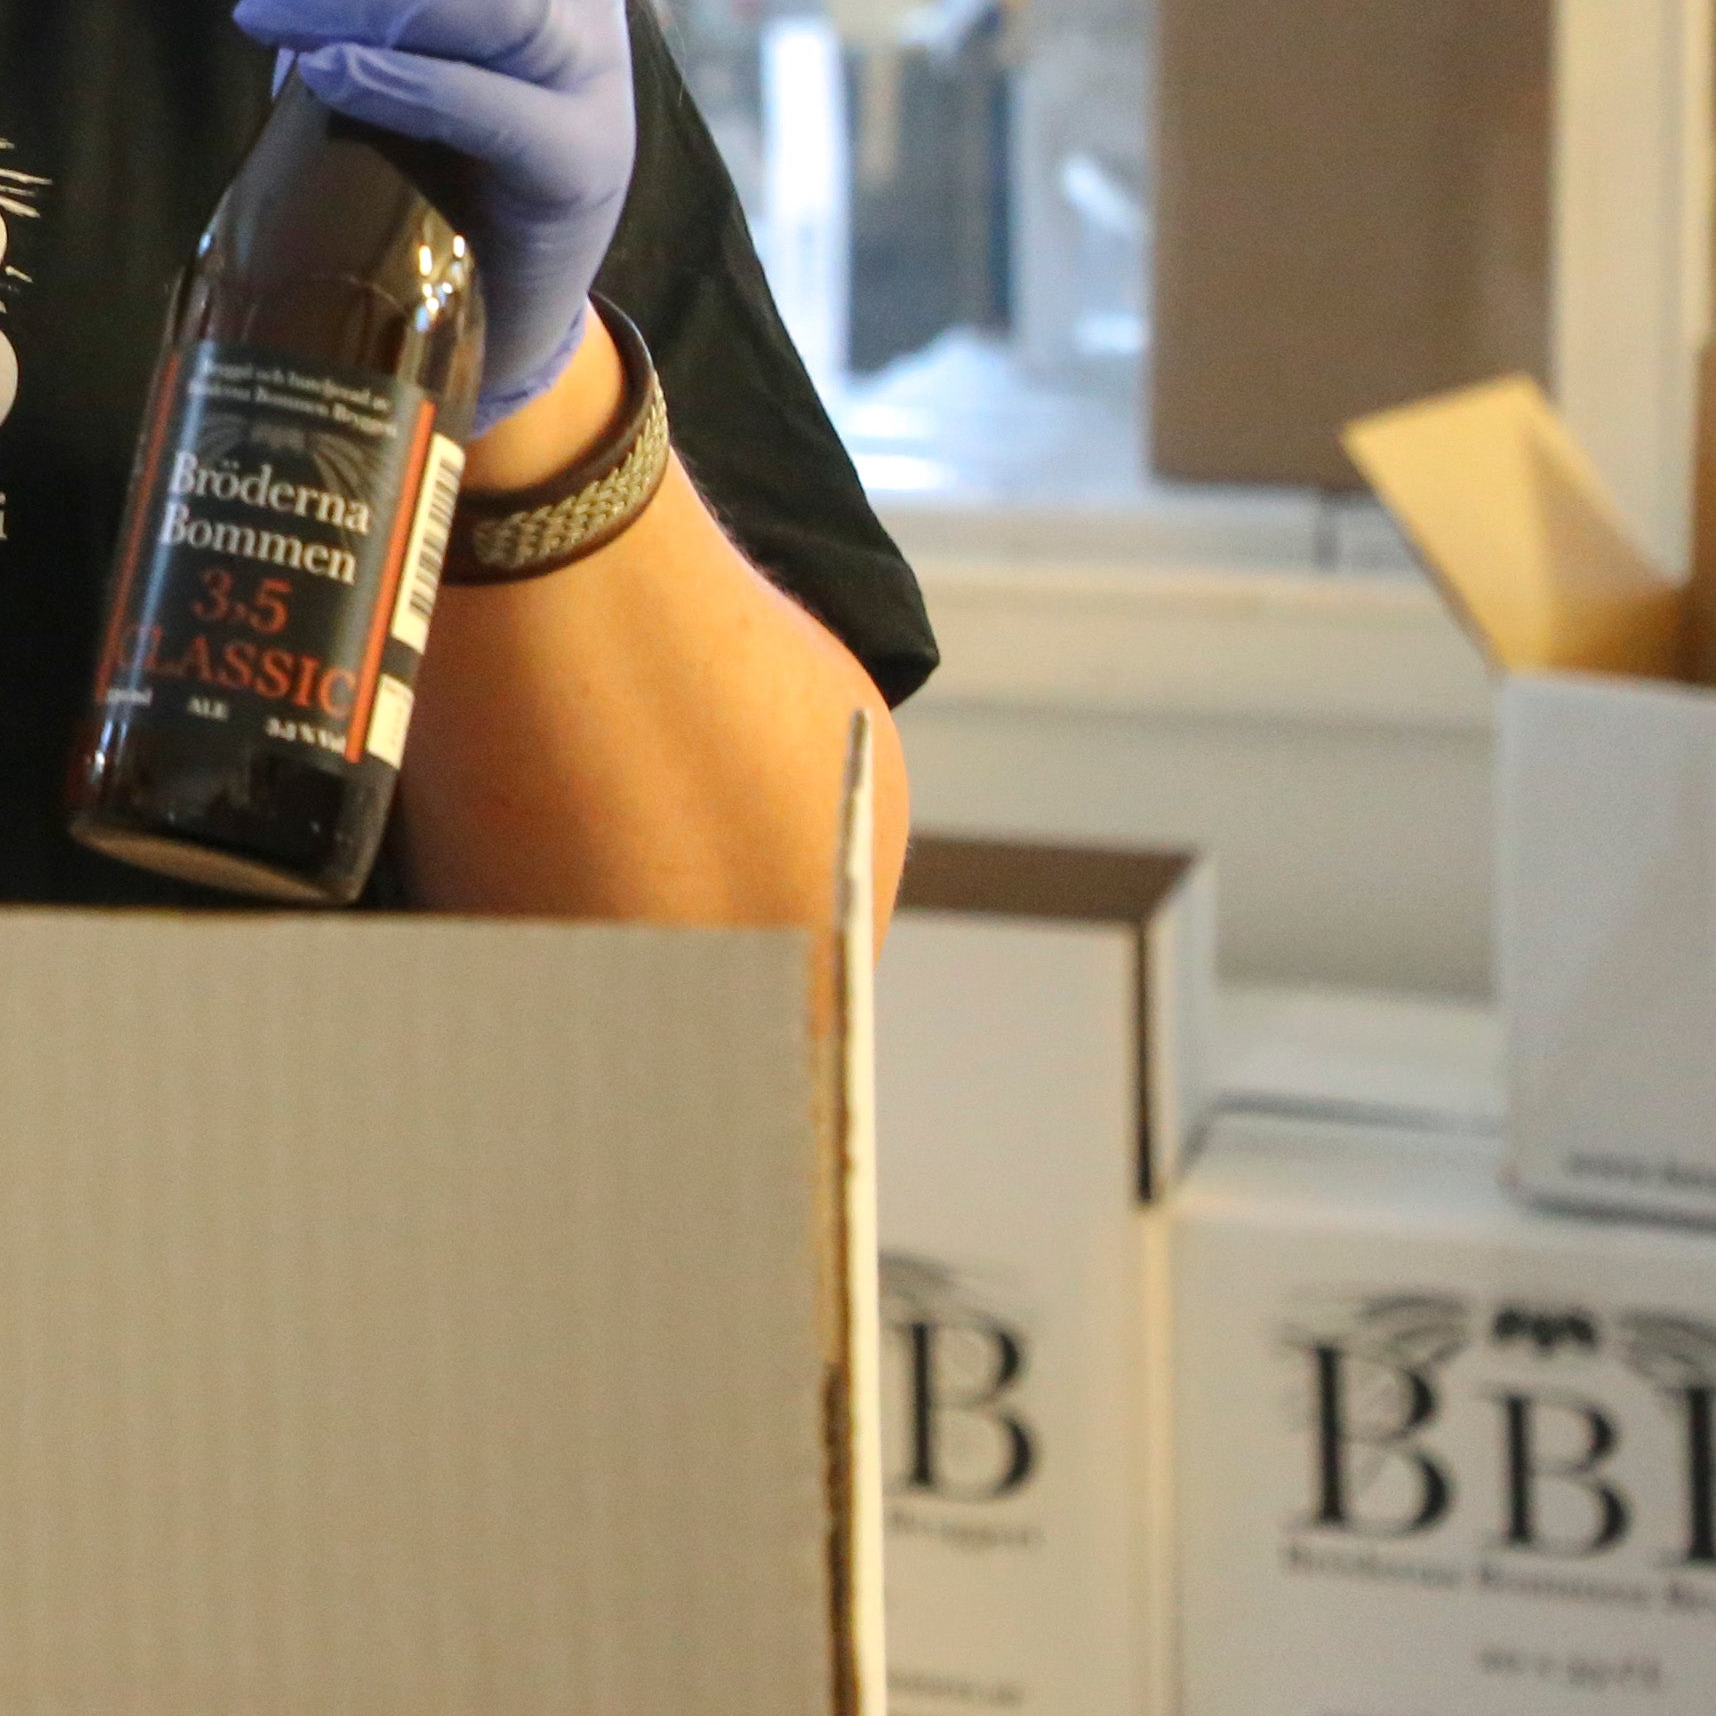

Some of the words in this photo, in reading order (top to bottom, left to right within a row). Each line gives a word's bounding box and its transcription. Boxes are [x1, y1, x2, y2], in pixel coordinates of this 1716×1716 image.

[169, 450, 370, 535] Bröderna
[158, 500, 357, 586] Bommen
[118, 622, 360, 722] LASSIC
